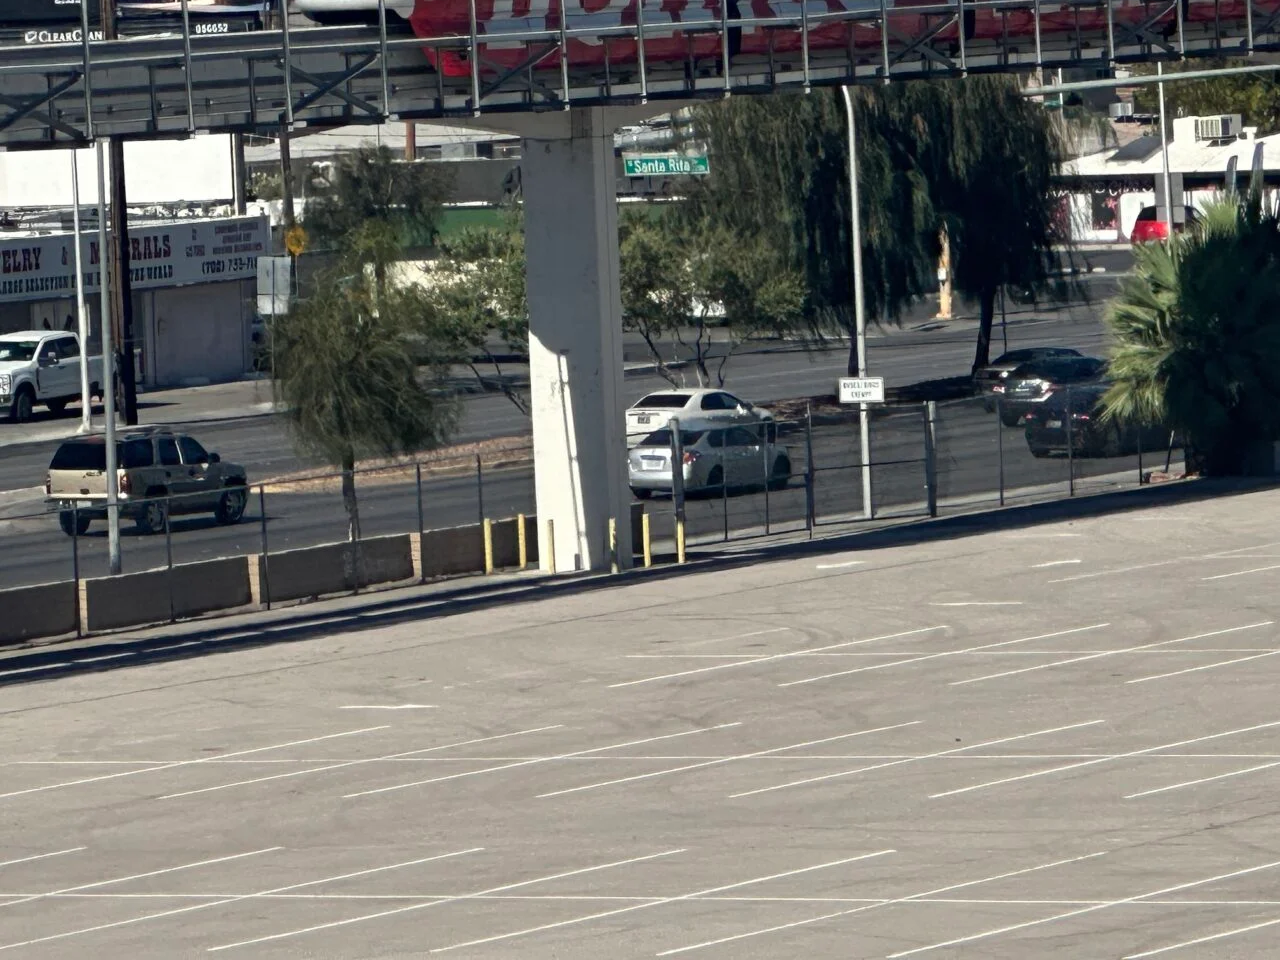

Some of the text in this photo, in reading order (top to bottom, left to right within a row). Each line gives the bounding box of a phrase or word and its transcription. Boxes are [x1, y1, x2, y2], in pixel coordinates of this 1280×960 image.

[634, 160, 665, 173] Santa
[669, 158, 690, 172] Rita
[61, 246, 68, 265] &
[90, 234, 171, 265] MRALS
